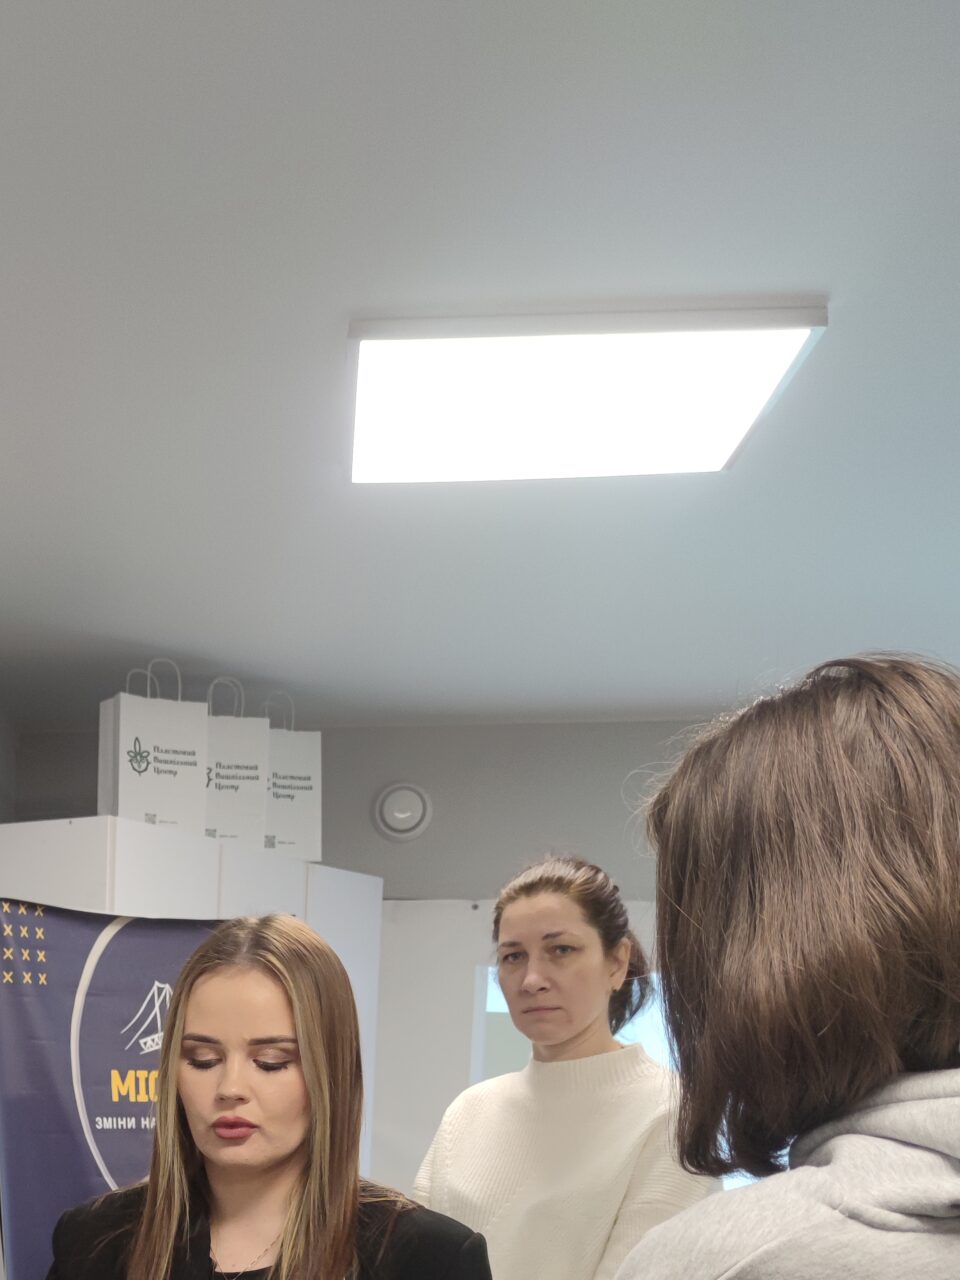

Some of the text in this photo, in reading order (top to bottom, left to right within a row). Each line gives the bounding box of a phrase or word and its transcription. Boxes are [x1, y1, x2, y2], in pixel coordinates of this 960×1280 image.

[153, 766, 178, 778] Центр
[214, 782, 240, 793] Центр
[110, 1068, 160, 1103] МІС
[95, 1116, 136, 1130] ЗМІНИ
